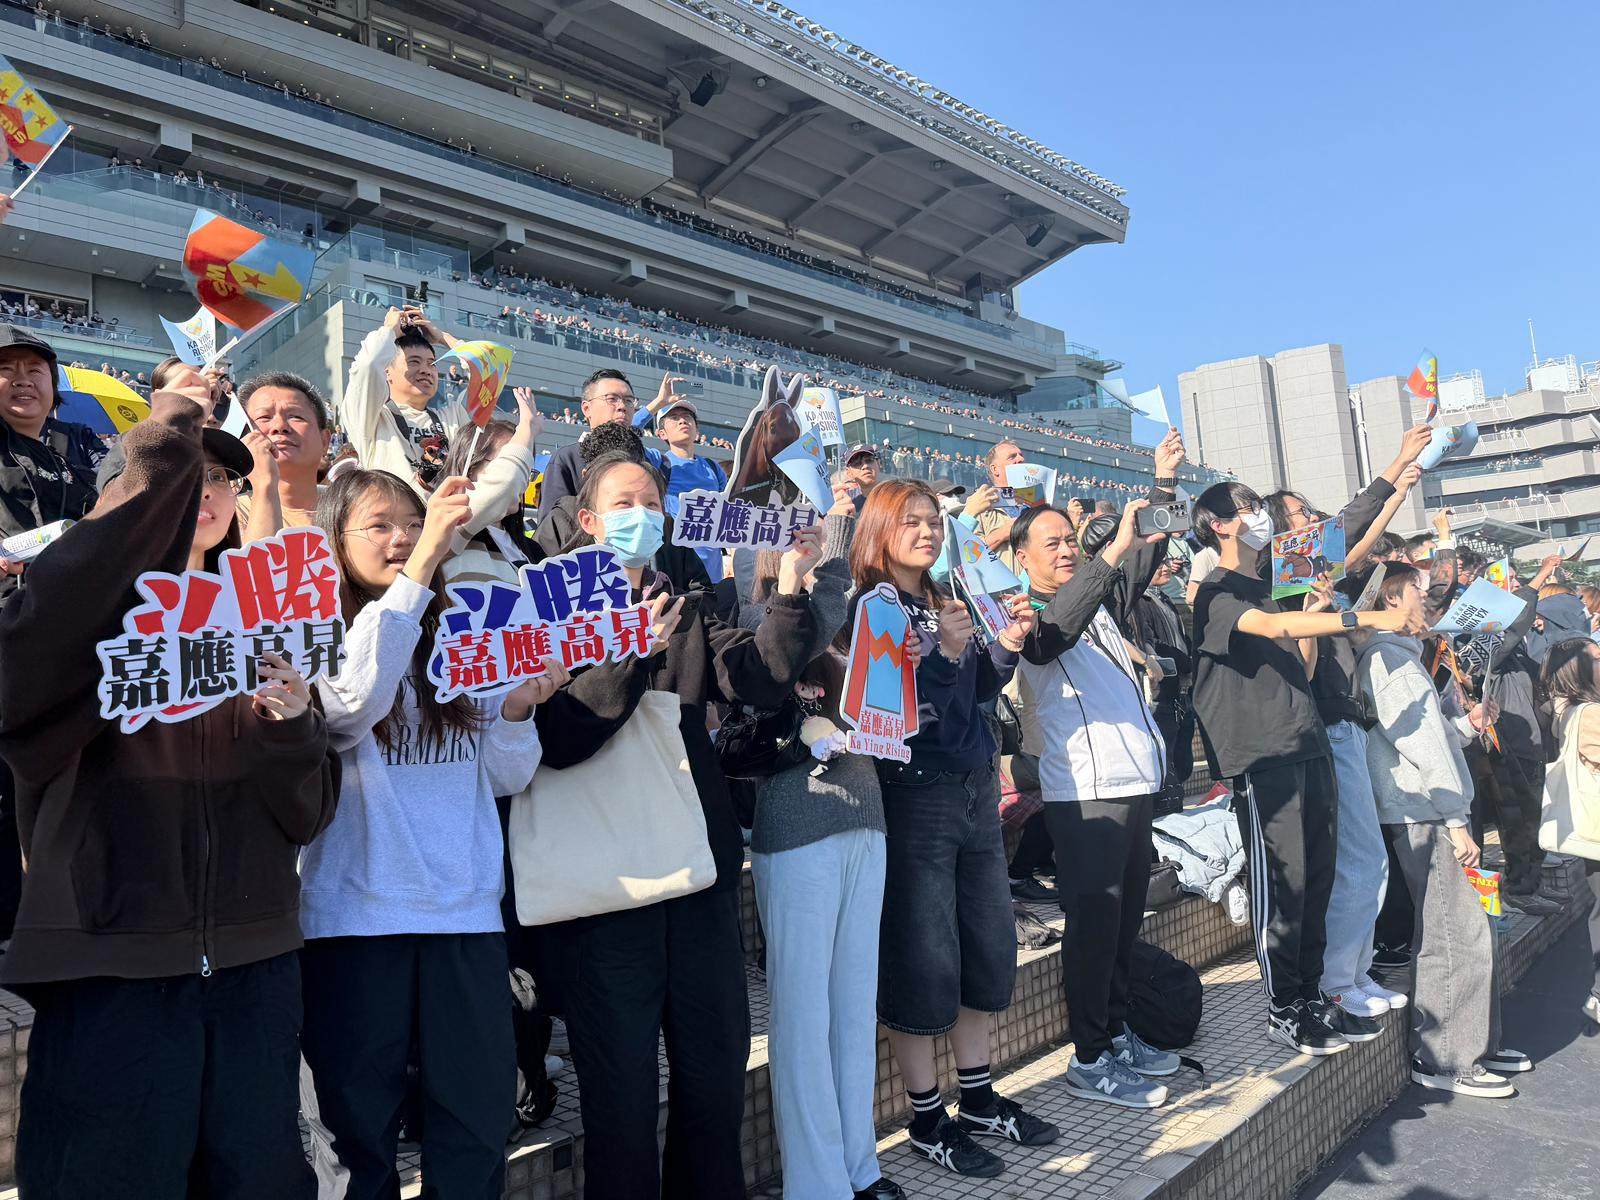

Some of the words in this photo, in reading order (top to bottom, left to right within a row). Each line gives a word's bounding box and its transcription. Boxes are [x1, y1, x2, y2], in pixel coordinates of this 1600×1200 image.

[187, 340, 198, 349] KA
[805, 411, 816, 421] KA
[819, 410, 836, 421] YING
[811, 421, 838, 431] SING
[678, 496, 815, 547] 嘉應高昇
[1455, 604, 1478, 627] RISING
[1475, 607, 1489, 619] KA
[1462, 618, 1481, 632] YING
[442, 607, 653, 689] 嘉應高昇
[104, 619, 345, 713] 嘉應高昇
[861, 710, 904, 741] 嘉應高昇
[376, 723, 477, 766] ARMERS
[850, 735, 861, 749] Ka
[864, 738, 883, 755] Ying
[886, 743, 910, 761] Rising
[1096, 1077, 1118, 1095] N
